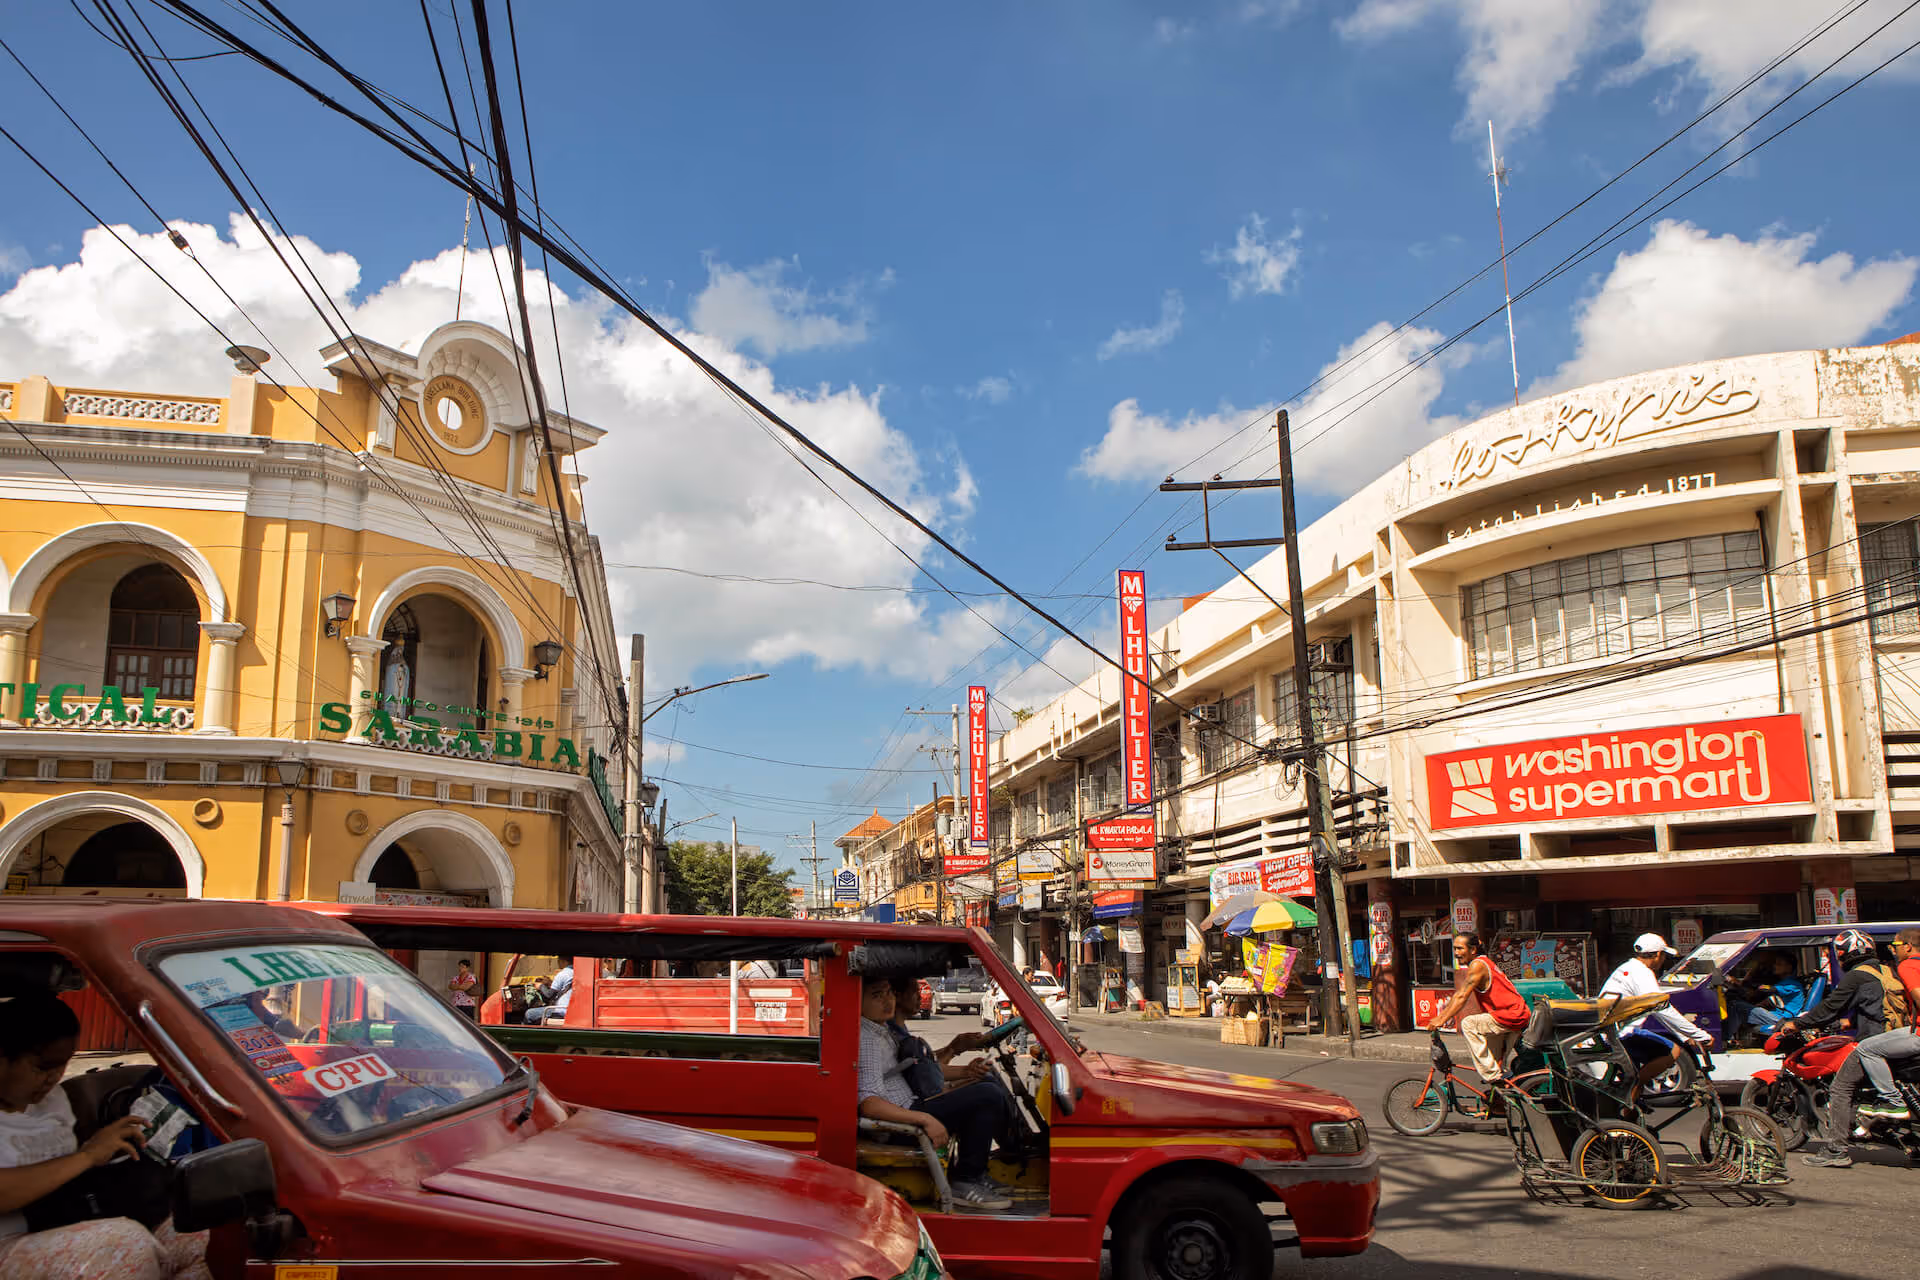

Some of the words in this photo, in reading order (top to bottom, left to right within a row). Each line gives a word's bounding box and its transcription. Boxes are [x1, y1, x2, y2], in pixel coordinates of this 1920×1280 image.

[1667, 471, 1717, 494] 1877
[446, 704, 508, 723] SINCE
[515, 715, 555, 730] 1945
[1125, 616, 1148, 800] LHUILLIER
[318, 702, 582, 768] SARABIA
[1504, 727, 1768, 778] washington
[973, 716, 986, 838] LHUILLIER
[1509, 759, 1770, 817] supermart
[1264, 858, 1286, 874] NOW
[1287, 853, 1313, 868] OPEN
[1227, 872, 1240, 885] BIG
[1240, 871, 1257, 885] SALE
[1456, 907, 1473, 916] BIG
[1846, 899, 1857, 908] BI
[1678, 928, 1697, 937] BIG
[314, 1055, 388, 1092] CPU
